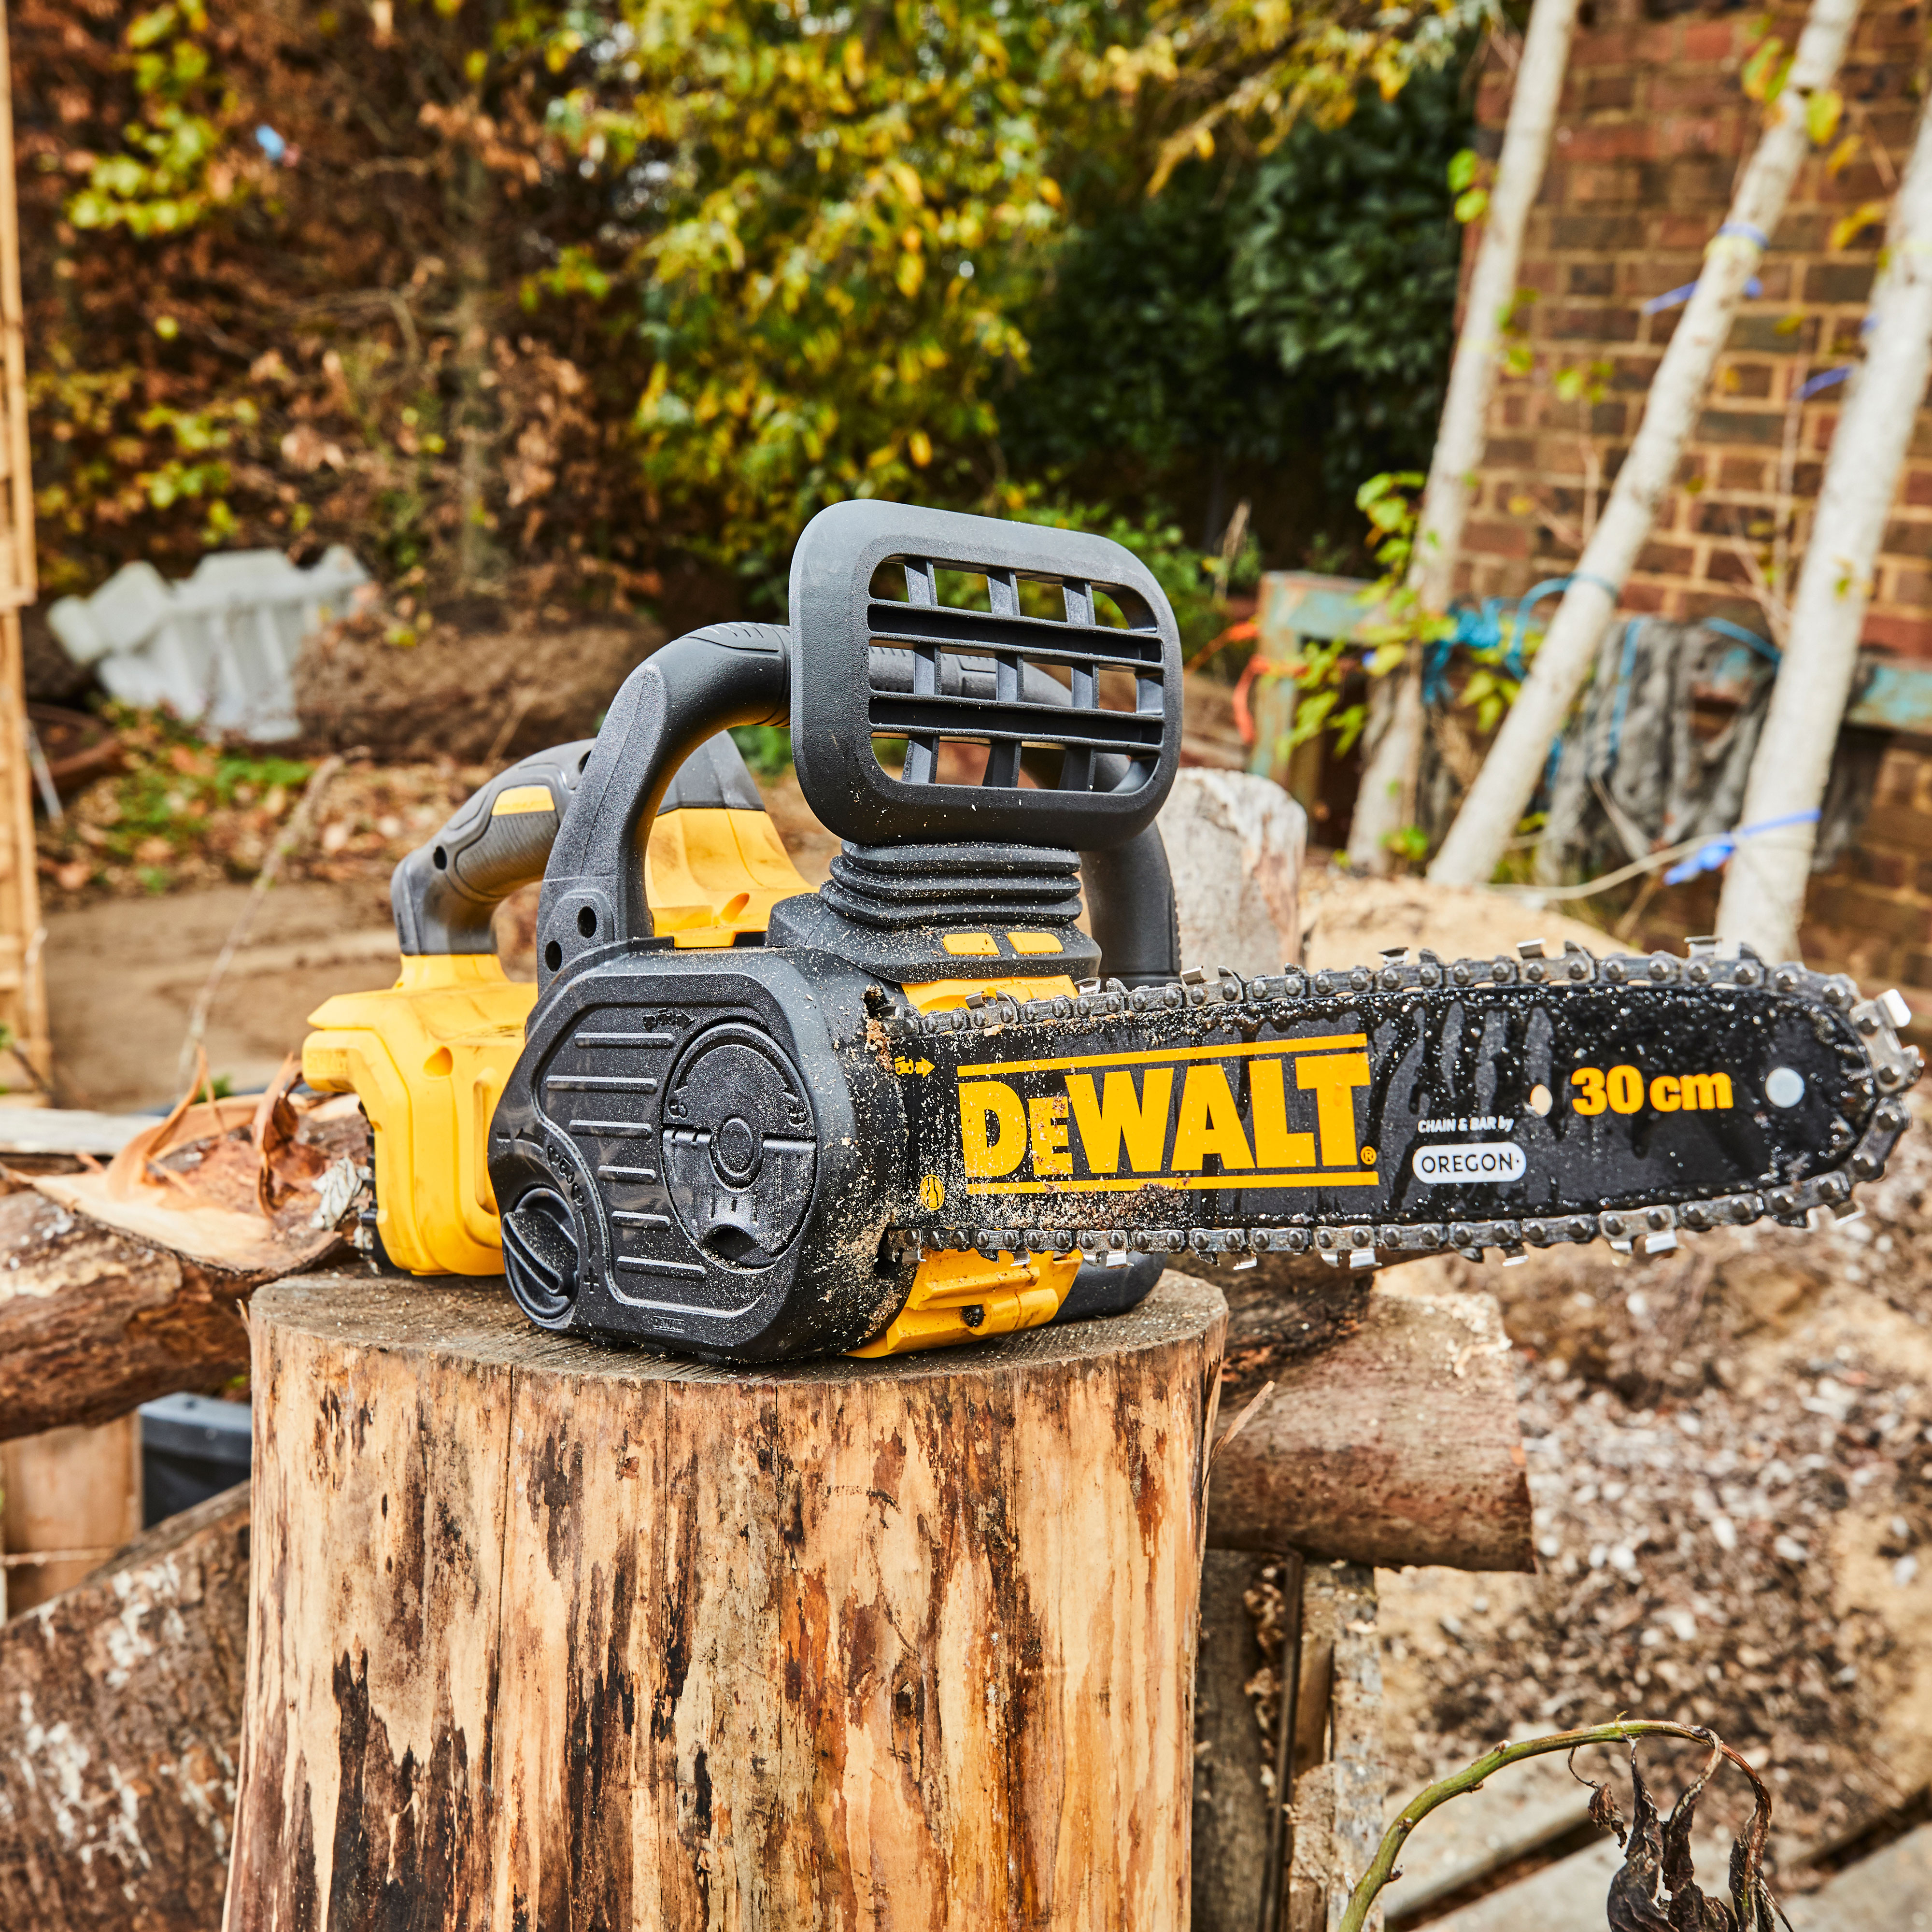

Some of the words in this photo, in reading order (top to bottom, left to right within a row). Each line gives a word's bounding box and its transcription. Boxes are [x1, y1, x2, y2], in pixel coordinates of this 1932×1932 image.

[1571, 1065, 1645, 1116] 30
[1649, 1072, 1733, 1112] cm
[1418, 1118, 1456, 1133] CHAIN
[1458, 1118, 1468, 1131] &
[1470, 1116, 1496, 1131] BAR
[1498, 1115, 1514, 1132] by
[1421, 1153, 1513, 1173] OREGON
